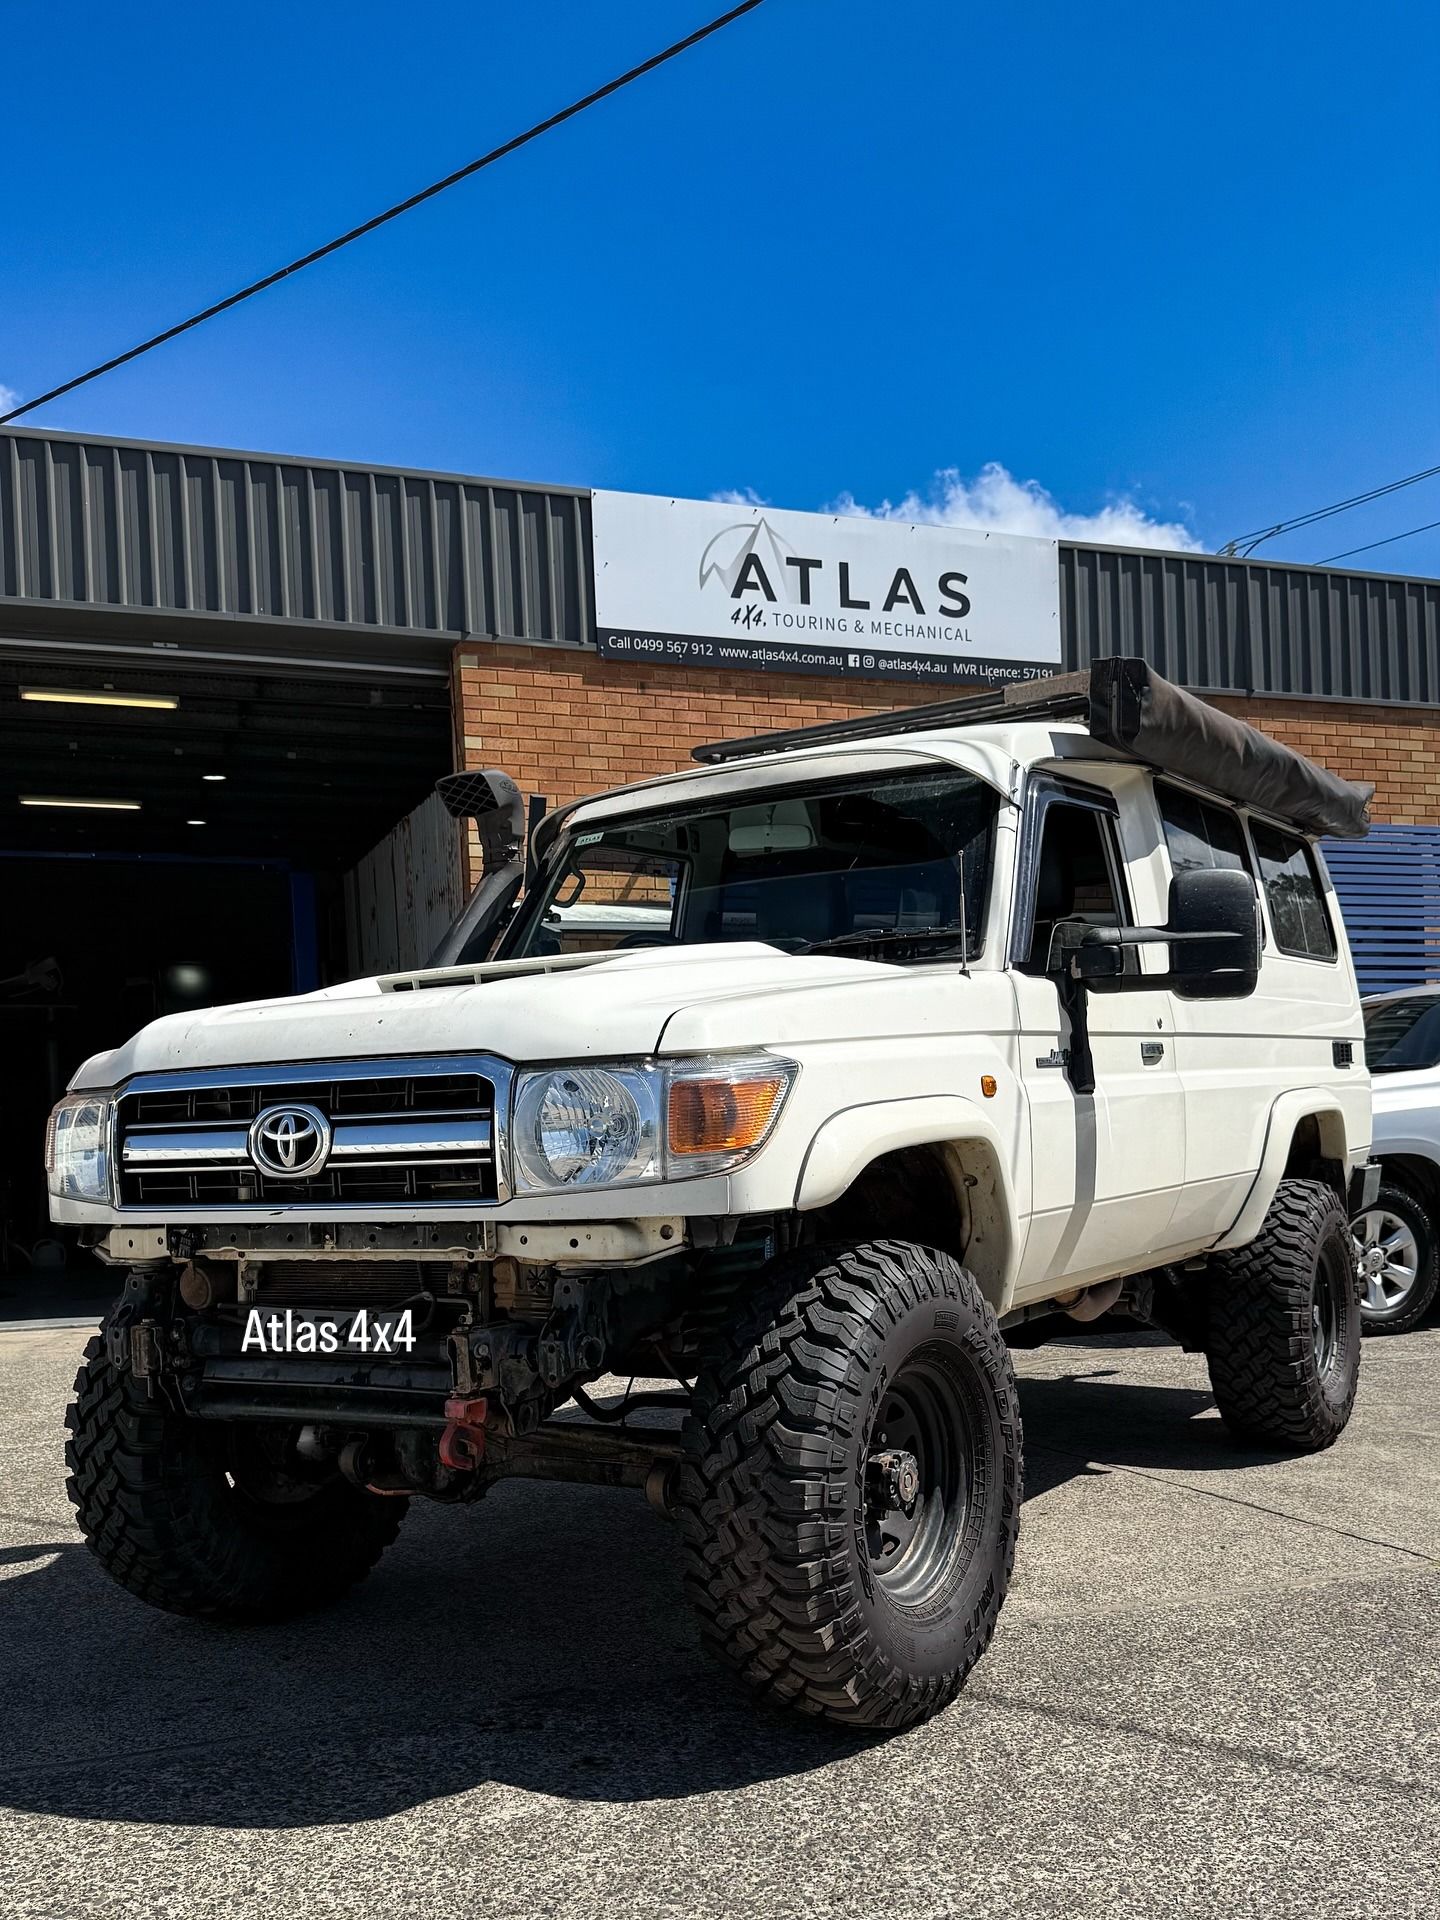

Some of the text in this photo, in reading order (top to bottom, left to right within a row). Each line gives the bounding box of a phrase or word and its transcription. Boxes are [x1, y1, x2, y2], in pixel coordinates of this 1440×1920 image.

[730, 552, 971, 618] ATLAS
[772, 613, 848, 632] TOURING
[854, 620, 865, 633] &
[871, 621, 973, 642] MECHANICAL
[608, 635, 631, 649] Call
[634, 638, 663, 652] 0499
[667, 641, 688, 653] 567
[691, 643, 714, 656] 912
[719, 647, 843, 666] www.atlas4x4.com.au
[878, 656, 948, 674] @atlas4x4.au
[953, 663, 977, 676] MVR
[979, 664, 1021, 679] Licence:
